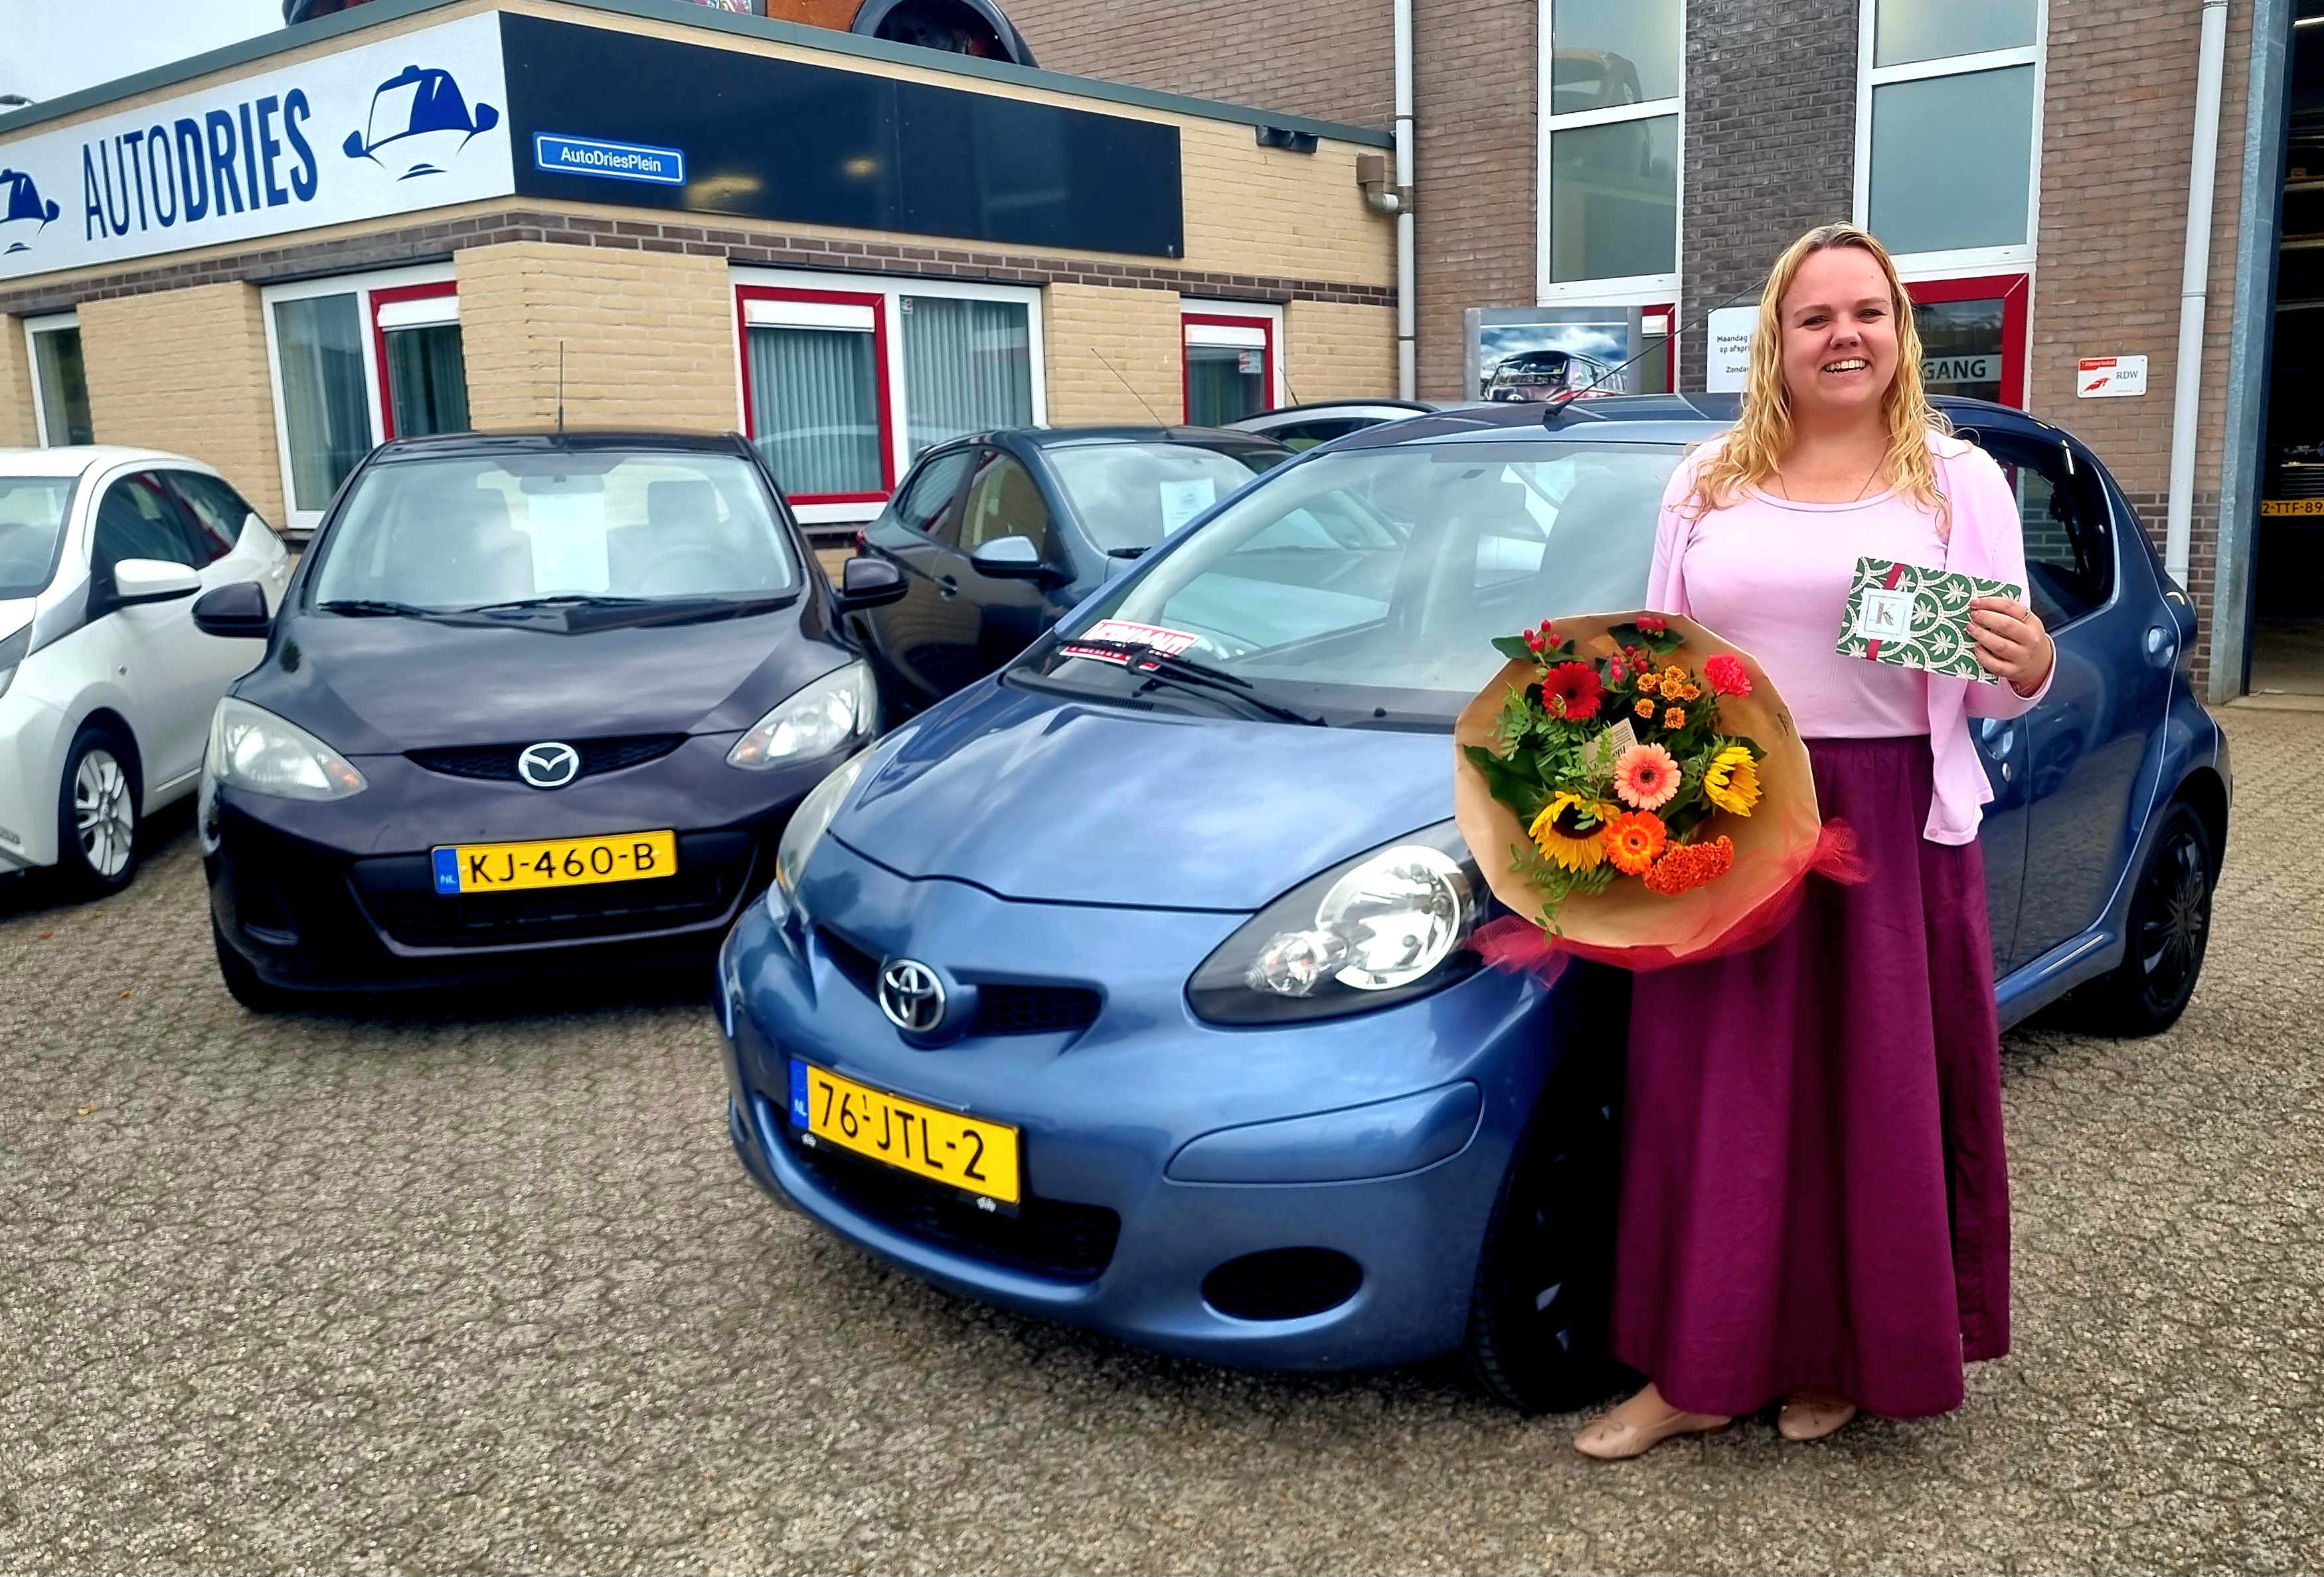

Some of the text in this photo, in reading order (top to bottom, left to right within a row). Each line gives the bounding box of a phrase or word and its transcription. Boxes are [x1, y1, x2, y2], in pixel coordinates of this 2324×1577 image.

[82, 88, 319, 242] AUTODRIES
[560, 146, 661, 173] AutoDriesPlein
[1730, 345, 1750, 353] afspr
[1923, 359, 1986, 380] GANG
[2116, 371, 2138, 379] RDW
[2262, 501, 2323, 514] 2-TTF-89
[1876, 600, 1894, 626] K
[469, 843, 655, 884] KJ-460-B
[818, 1080, 986, 1182] 76-JTL-2
